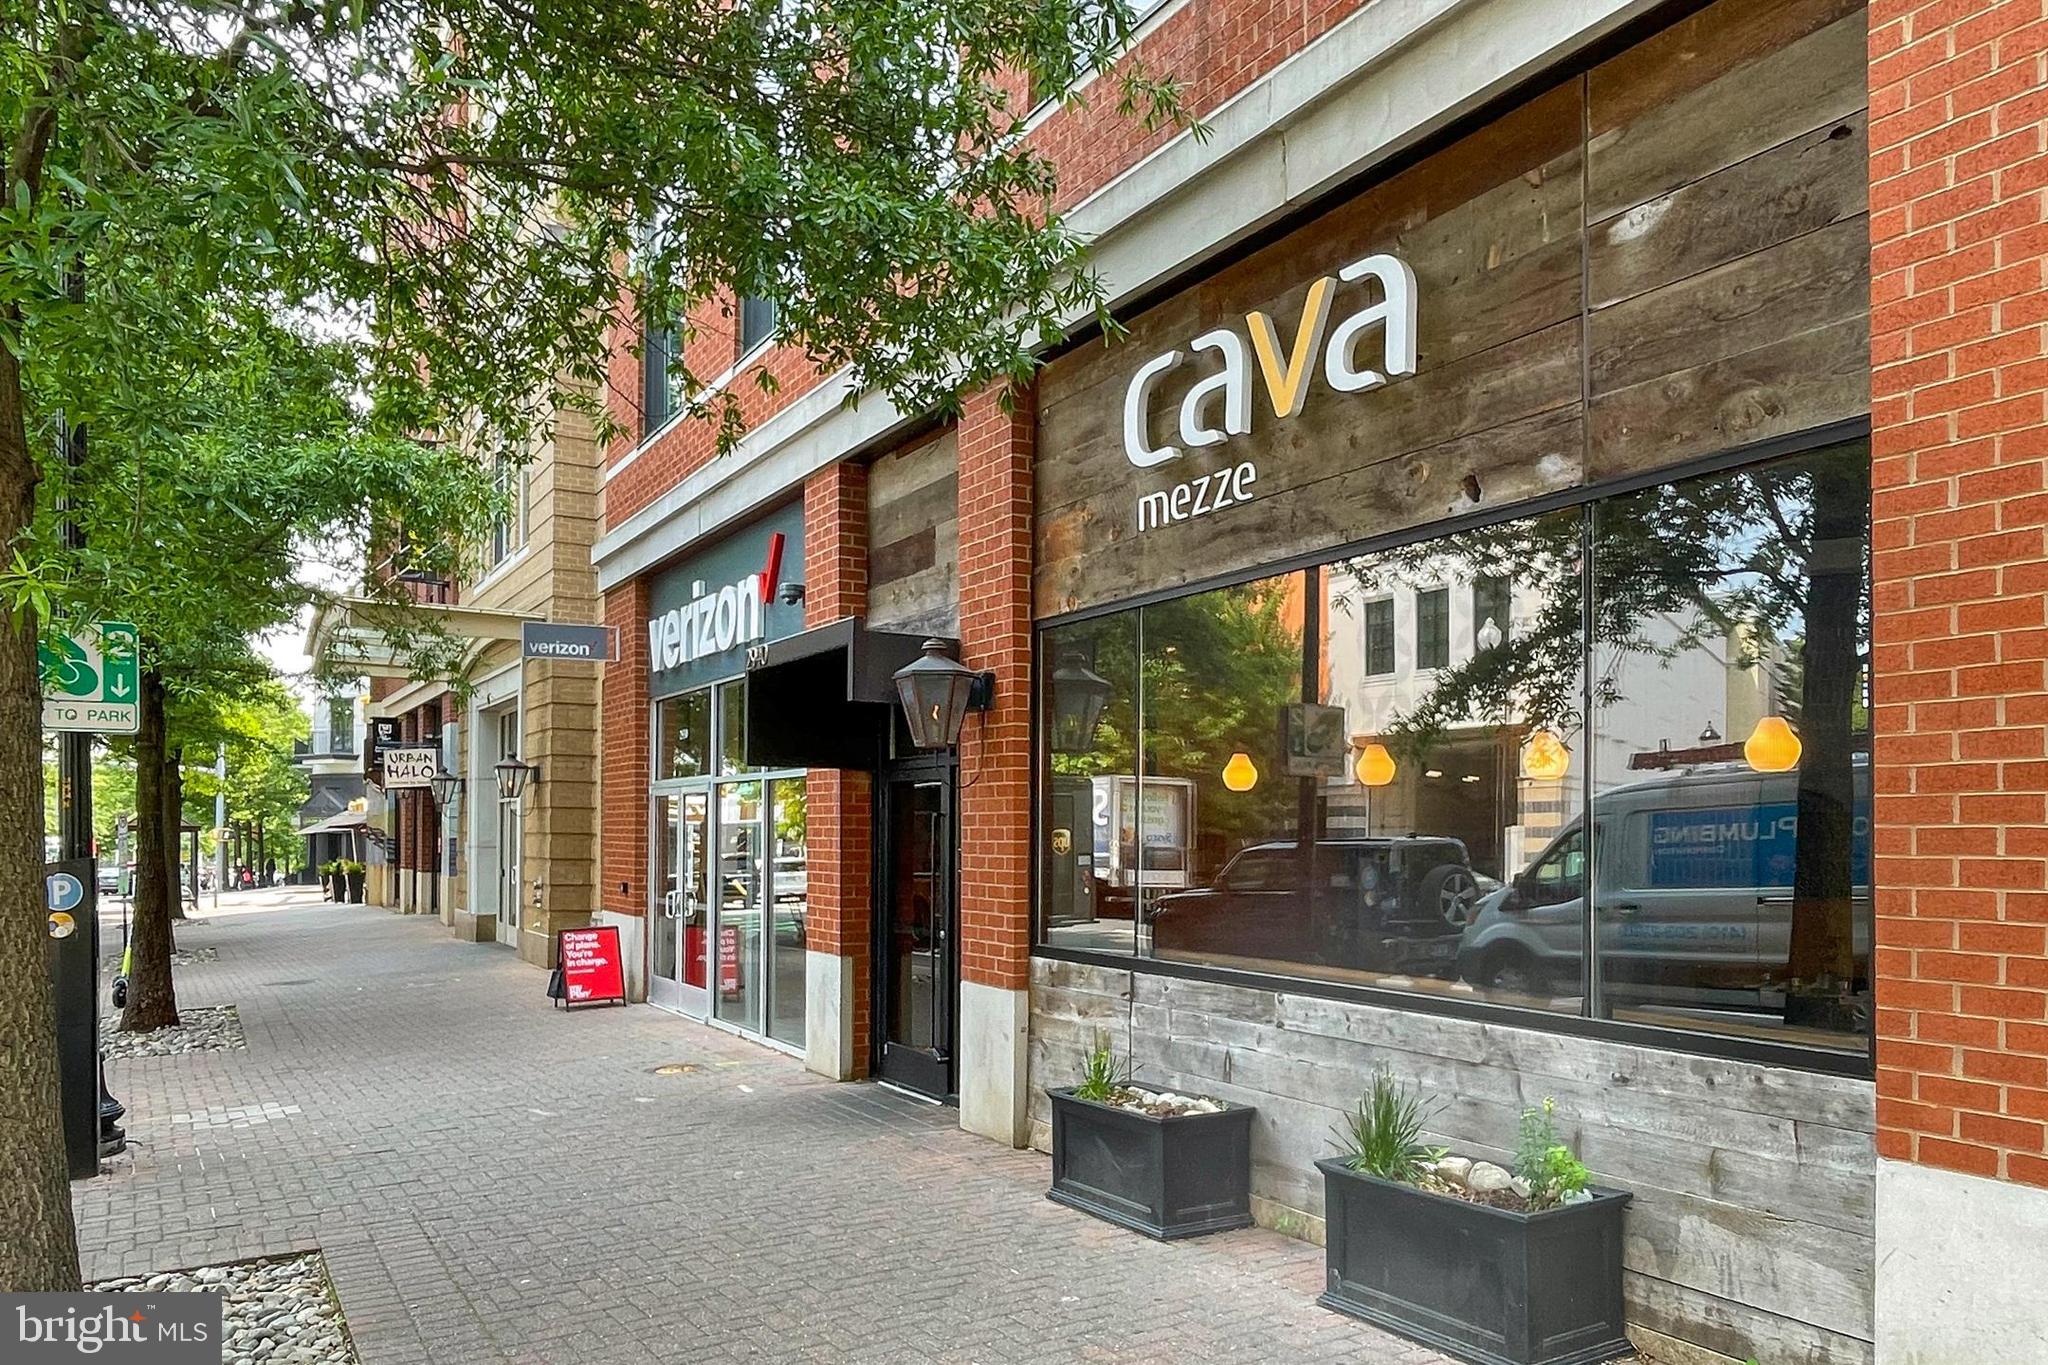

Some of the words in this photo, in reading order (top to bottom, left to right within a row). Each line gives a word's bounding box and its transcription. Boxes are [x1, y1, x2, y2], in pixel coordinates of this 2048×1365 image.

[1123, 254, 1417, 468] cava
[1138, 460, 1257, 533] mezze
[649, 579, 765, 673] verizon
[529, 641, 590, 656] verizon
[54, 708, 78, 721] TO
[87, 709, 132, 722] PARK
[389, 752, 433, 764] URBAN
[387, 764, 434, 779] HALO
[53, 880, 71, 905] P
[564, 932, 598, 942] Change
[565, 942, 575, 950] of
[565, 950, 593, 959] You're
[566, 958, 576, 967] in
